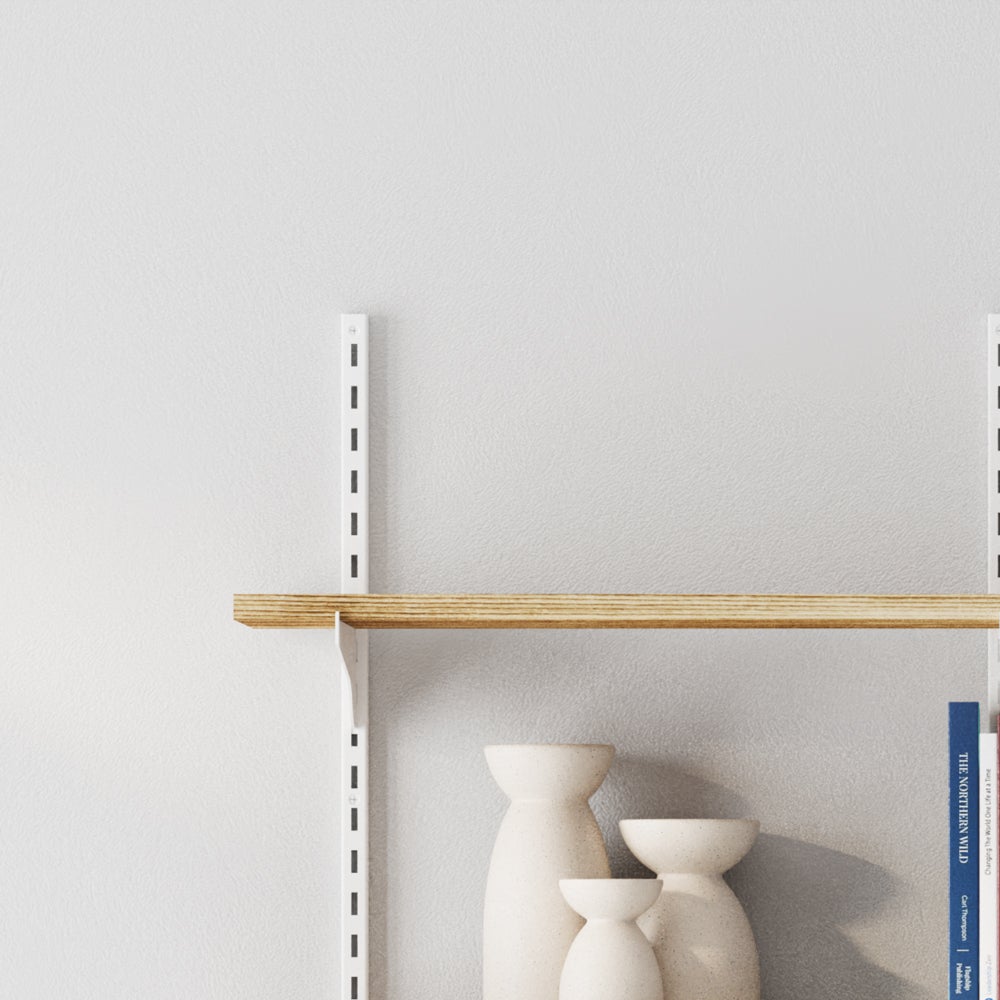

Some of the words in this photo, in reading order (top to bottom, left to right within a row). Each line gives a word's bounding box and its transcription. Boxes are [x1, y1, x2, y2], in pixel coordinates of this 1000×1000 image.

[958, 752, 969, 774] THE
[958, 776, 969, 834] NORTHERN
[958, 836, 969, 864] WILD
